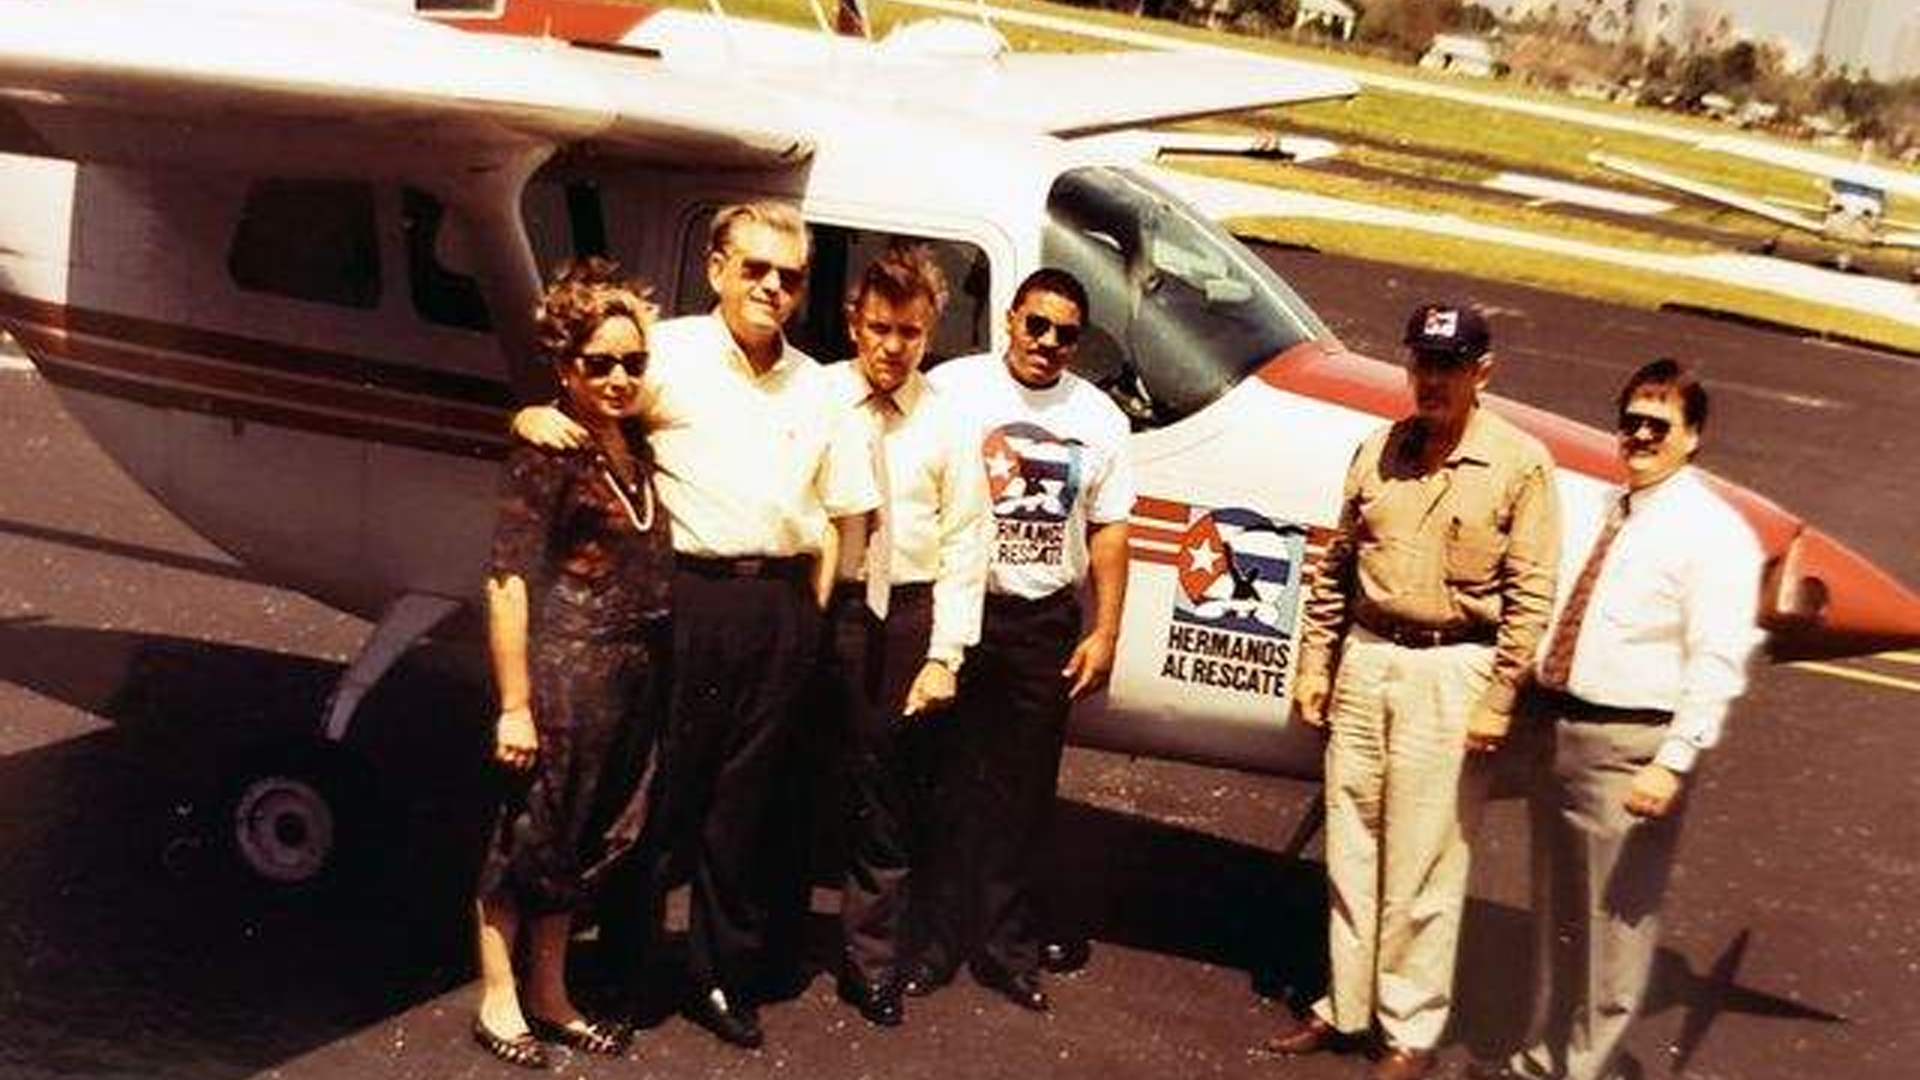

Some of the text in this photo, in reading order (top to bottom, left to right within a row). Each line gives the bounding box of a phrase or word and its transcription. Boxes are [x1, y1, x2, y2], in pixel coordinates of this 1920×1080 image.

[994, 521, 1065, 544] RMANOS
[1168, 624, 1291, 669] HERMANOS
[1160, 654, 1286, 698] AL RESCATE
